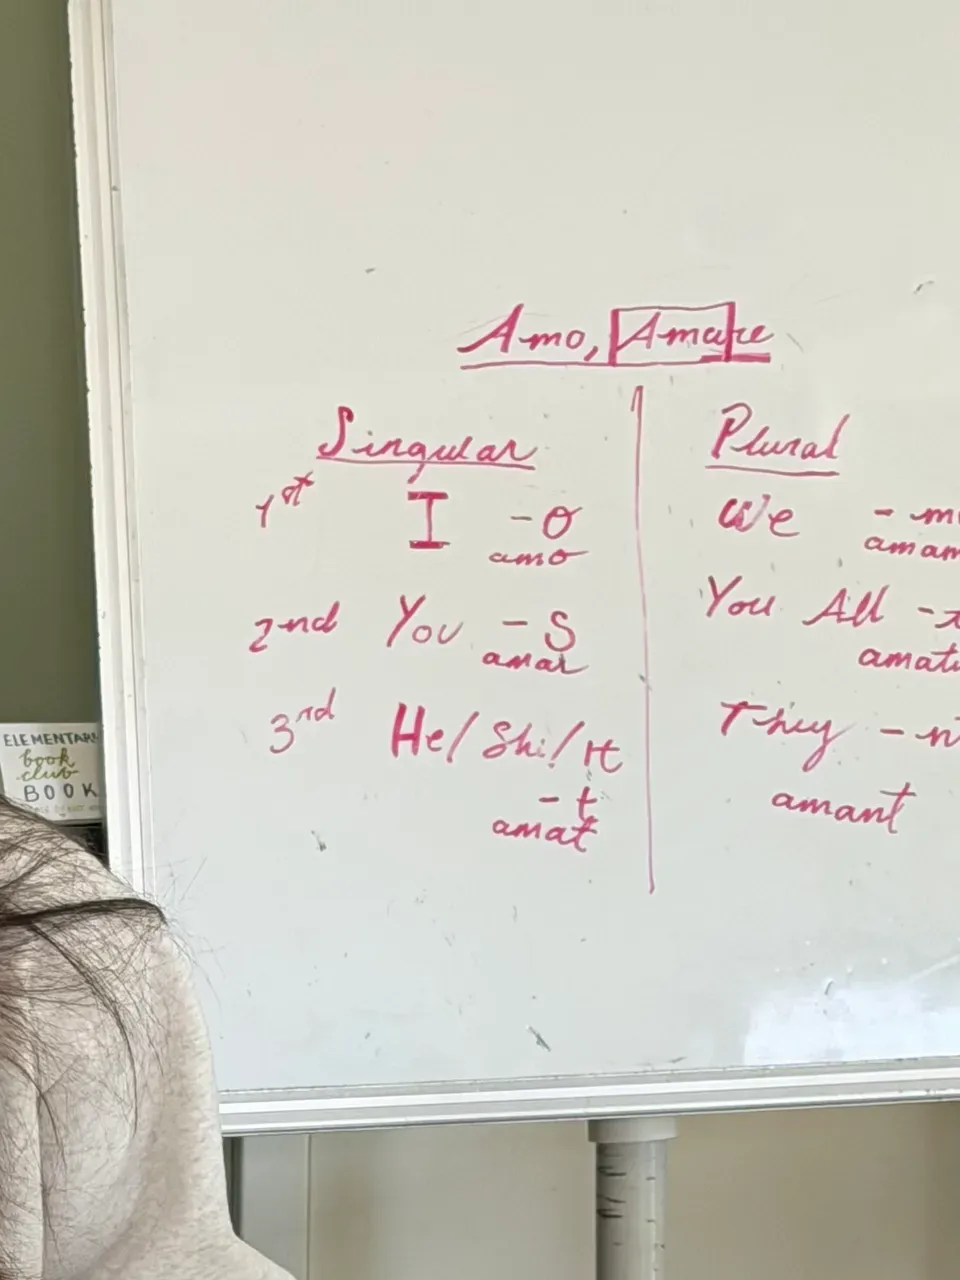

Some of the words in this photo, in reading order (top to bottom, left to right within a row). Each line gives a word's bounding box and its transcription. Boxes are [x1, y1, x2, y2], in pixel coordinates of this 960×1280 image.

[317, 405, 538, 484] Singular
[711, 402, 850, 460] Plural
[407, 491, 451, 549] I
[718, 494, 800, 538] We
[489, 548, 589, 567] amo
[248, 601, 340, 653] 2nd
[386, 594, 464, 648] You
[705, 575, 776, 618] You
[801, 584, 890, 628] All
[270, 686, 336, 754] 3rd
[18, 747, 76, 768] book
[492, 814, 599, 853] amat
[771, 782, 917, 834] amant
